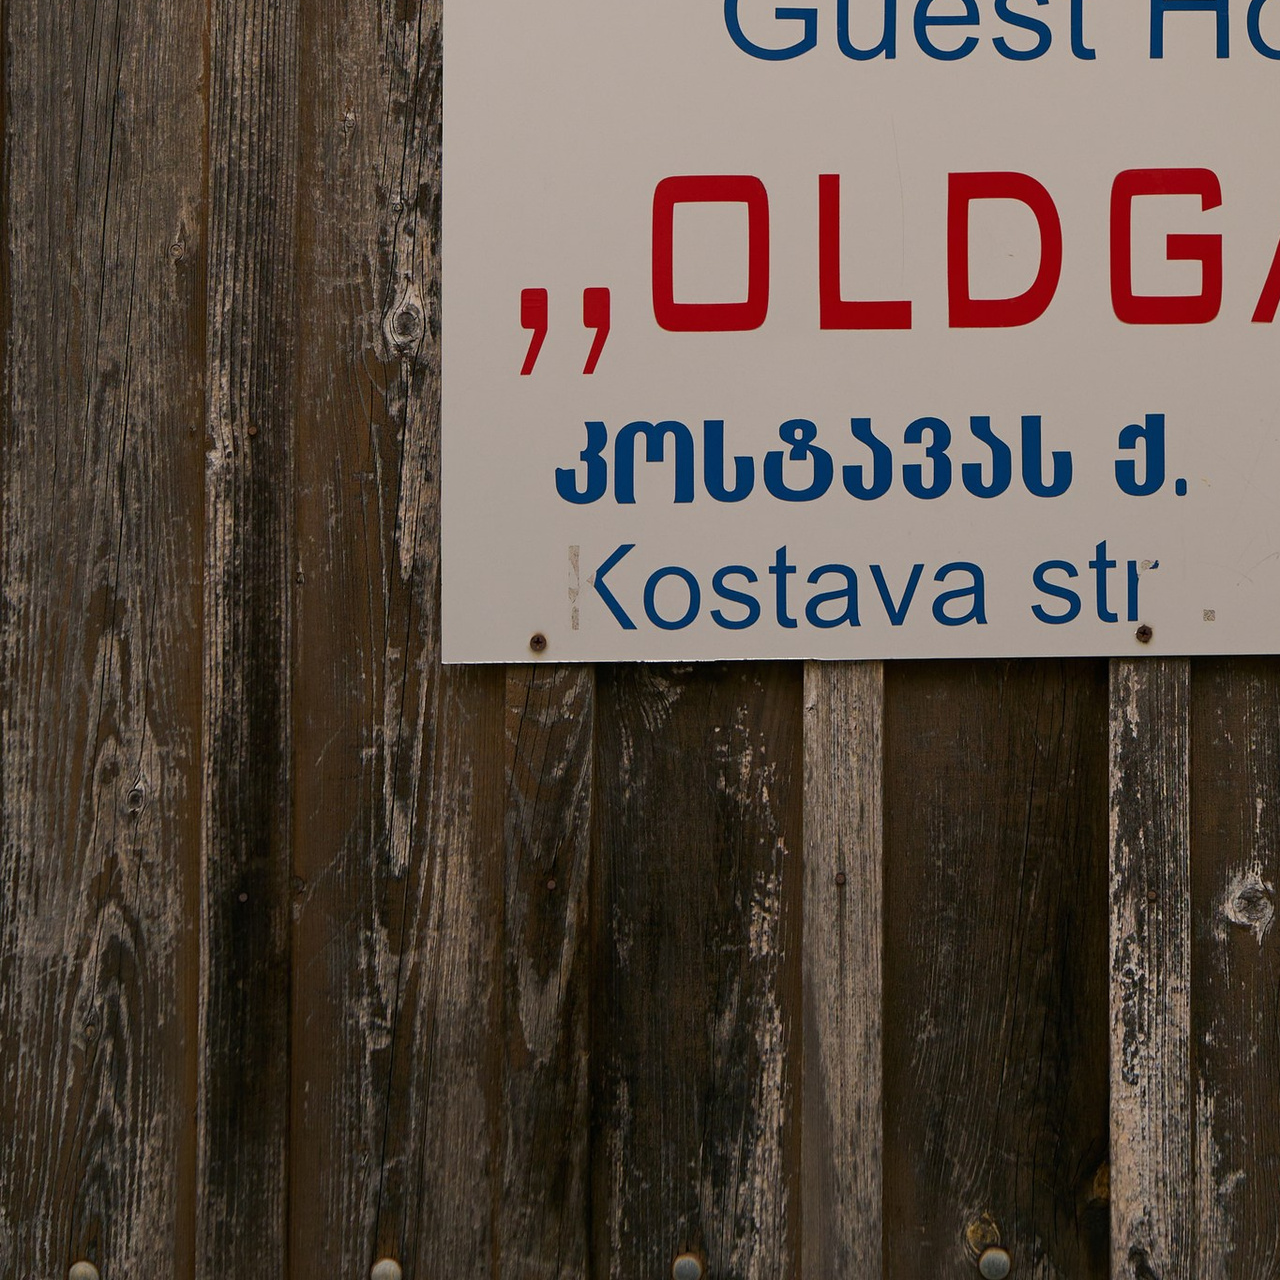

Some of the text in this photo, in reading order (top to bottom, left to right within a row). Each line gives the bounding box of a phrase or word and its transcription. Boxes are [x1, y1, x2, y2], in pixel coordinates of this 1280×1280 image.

[554, 412, 1188, 506] კოსტავას ქ.
[567, 543, 989, 633] Kostava
